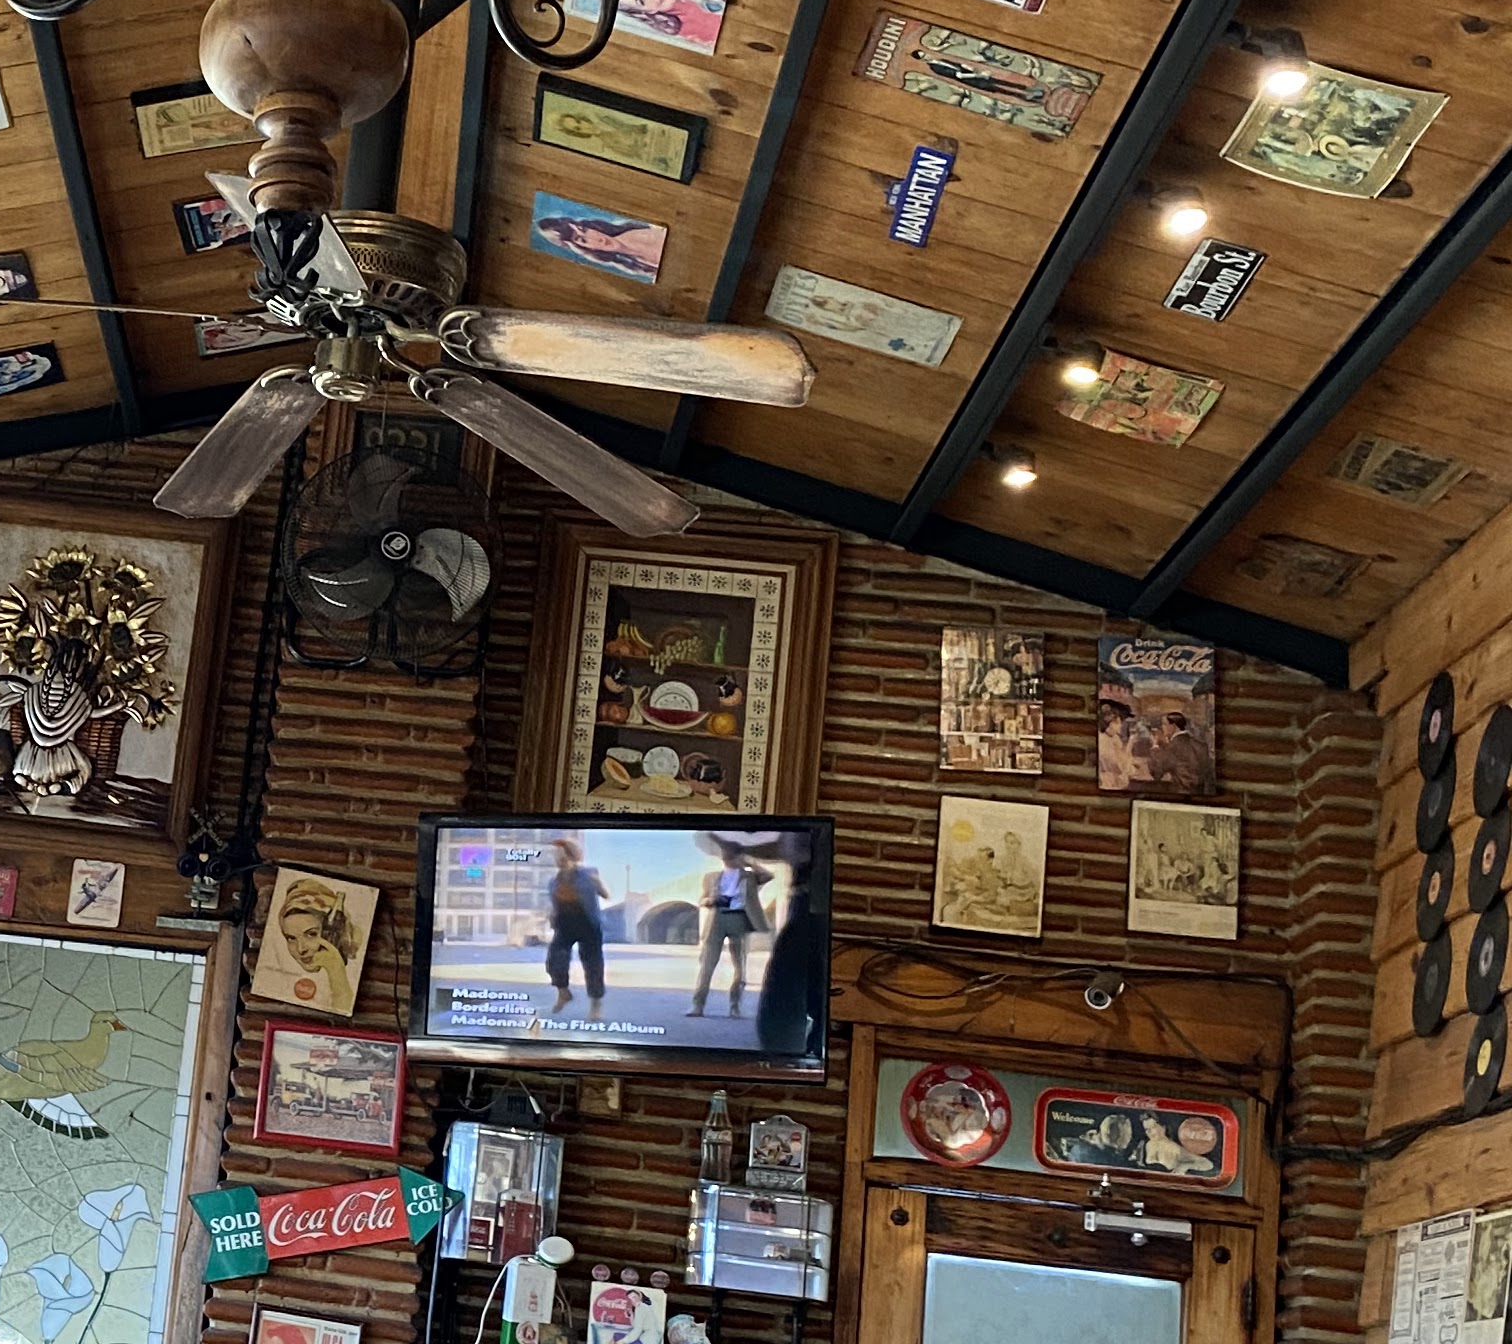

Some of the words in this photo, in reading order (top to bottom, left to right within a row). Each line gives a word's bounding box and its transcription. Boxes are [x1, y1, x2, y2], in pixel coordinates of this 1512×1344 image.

[865, 17, 908, 81] HOUDINI
[894, 152, 948, 244] MANHATTAN
[1134, 638, 1165, 648] Drink
[1110, 643, 1215, 674] Coca-Cola
[452, 988, 529, 1001] Madonna
[451, 1002, 536, 1015] Borderline
[570, 1019, 606, 1032] First
[609, 1021, 666, 1035] Album
[1051, 1111, 1096, 1125] Welcome
[411, 1183, 439, 1202] ICE
[406, 1197, 454, 1217] COLD
[210, 1211, 261, 1235] SOLD
[268, 1188, 397, 1247] Coca-Cola
[215, 1230, 264, 1254] HERE
